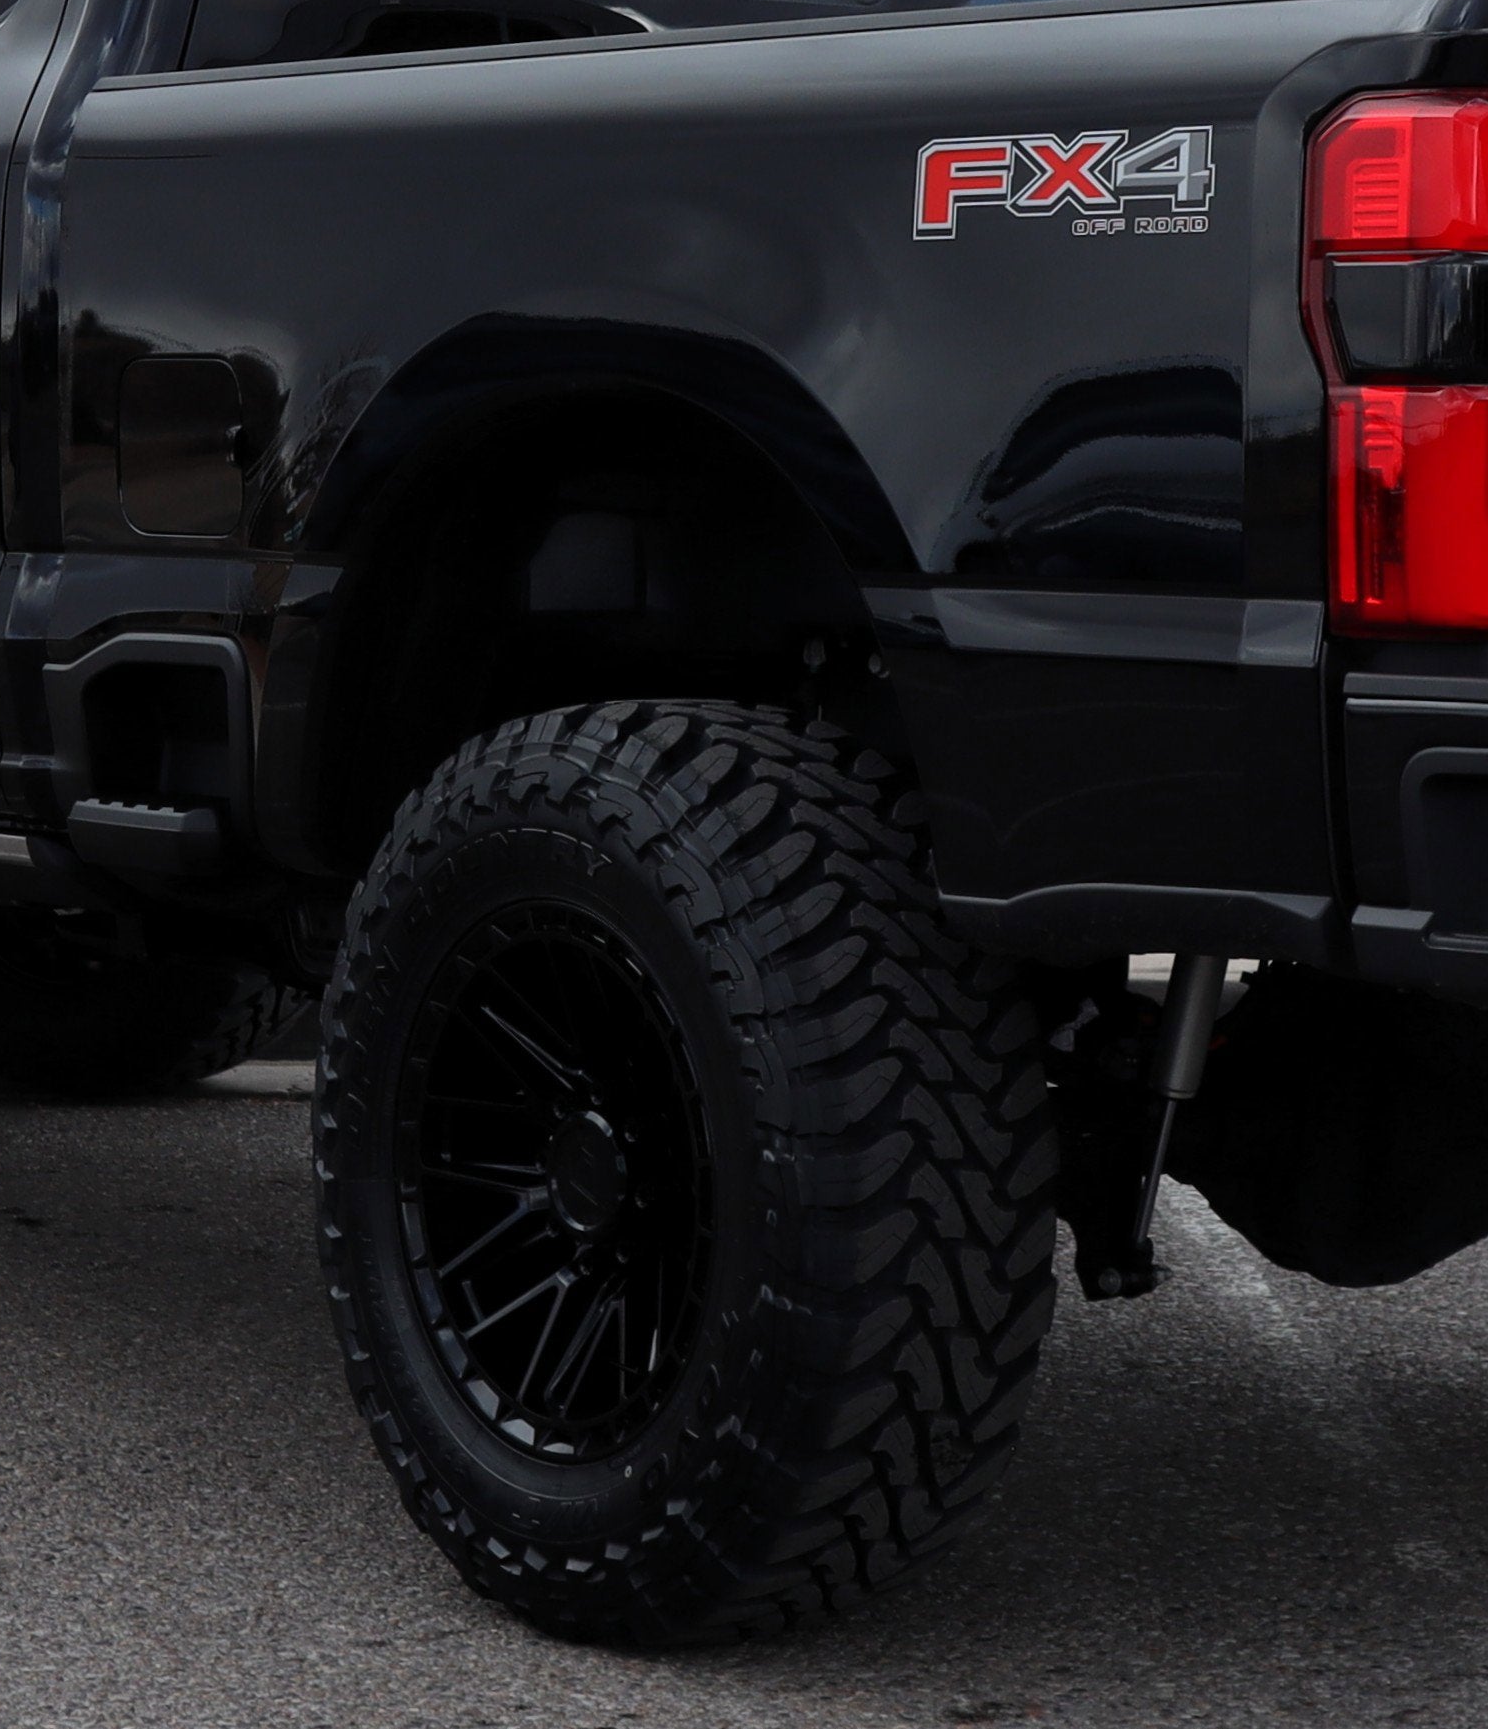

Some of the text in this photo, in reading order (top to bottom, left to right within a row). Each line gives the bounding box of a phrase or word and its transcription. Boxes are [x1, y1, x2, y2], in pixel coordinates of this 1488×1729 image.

[913, 125, 1215, 240] FX4
[1071, 215, 1209, 236] OFF ROAD
